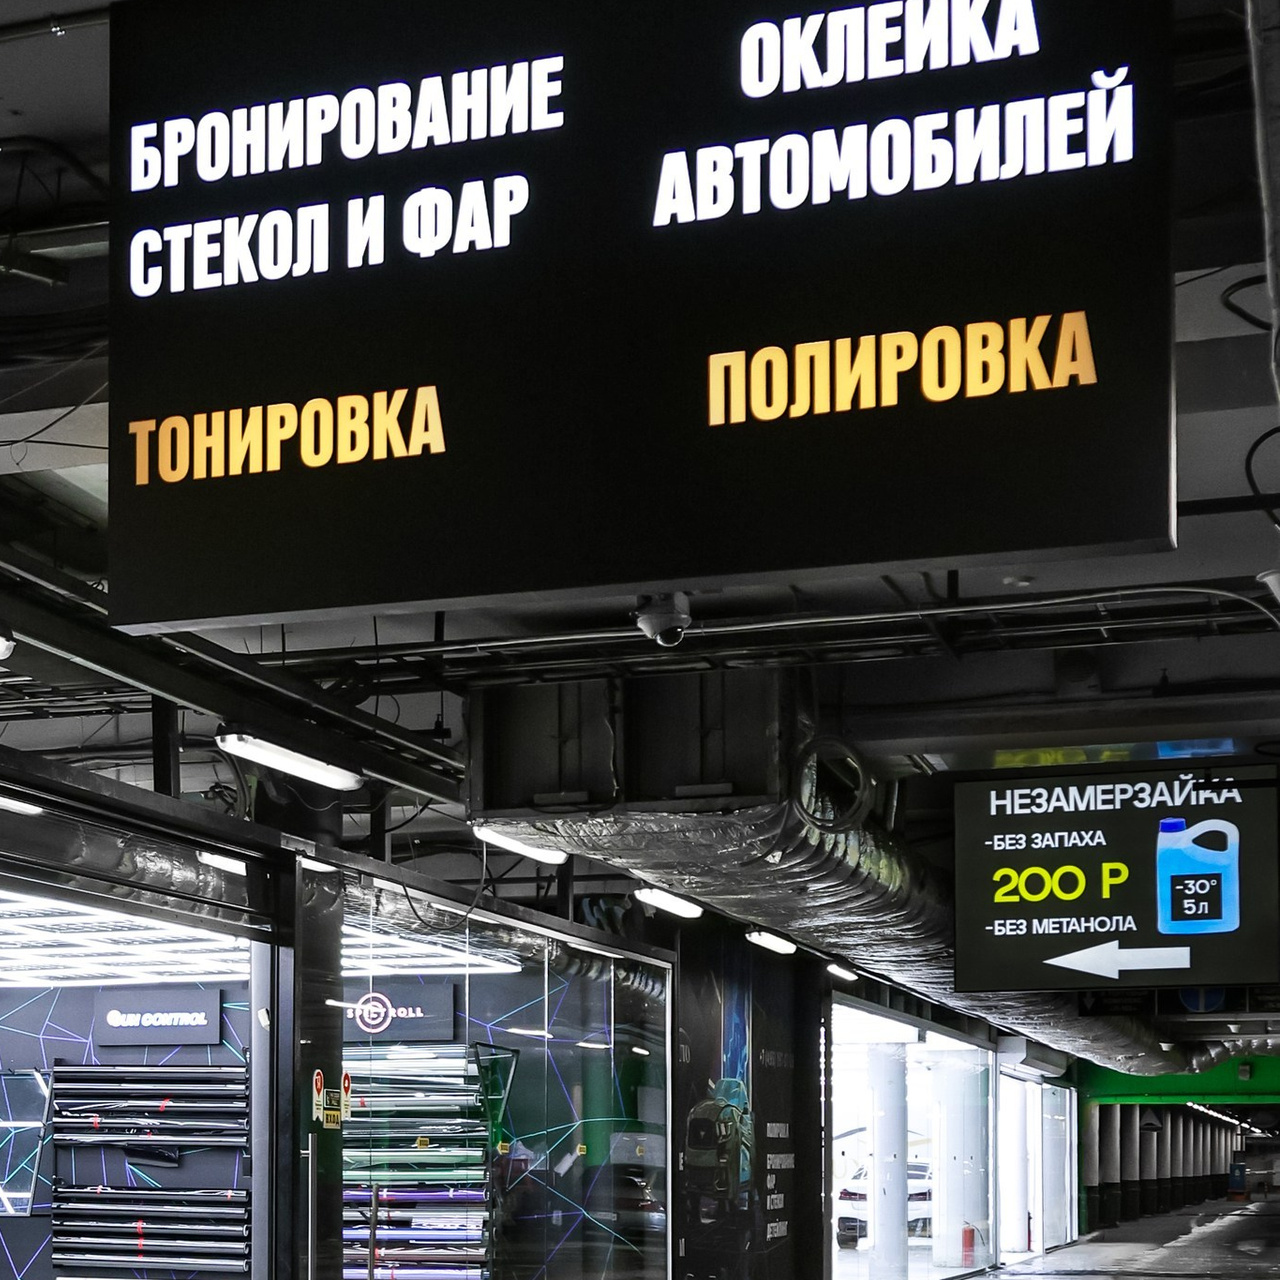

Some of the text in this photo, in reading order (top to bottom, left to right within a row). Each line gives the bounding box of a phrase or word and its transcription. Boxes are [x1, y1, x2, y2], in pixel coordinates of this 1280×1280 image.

[130, 55, 565, 192] БРОНИРОВАНИЕ
[653, 66, 1134, 226] АВТОМОБИЛЕЙ
[129, 174, 530, 298] СТЕКОЛ И ФАР
[708, 310, 1098, 427] ПОЛИРОВКА
[128, 385, 446, 486] ТОНИРОВКА
[989, 773, 1243, 816] НЕЗАМЕРЗАЙКА
[984, 830, 1107, 851] -БЕЗ ЗАПАХА
[992, 865, 1087, 903] 200
[1182, 898, 1209, 915] 5л
[984, 915, 1138, 936] -БЕЗ МЕТАНОЛА
